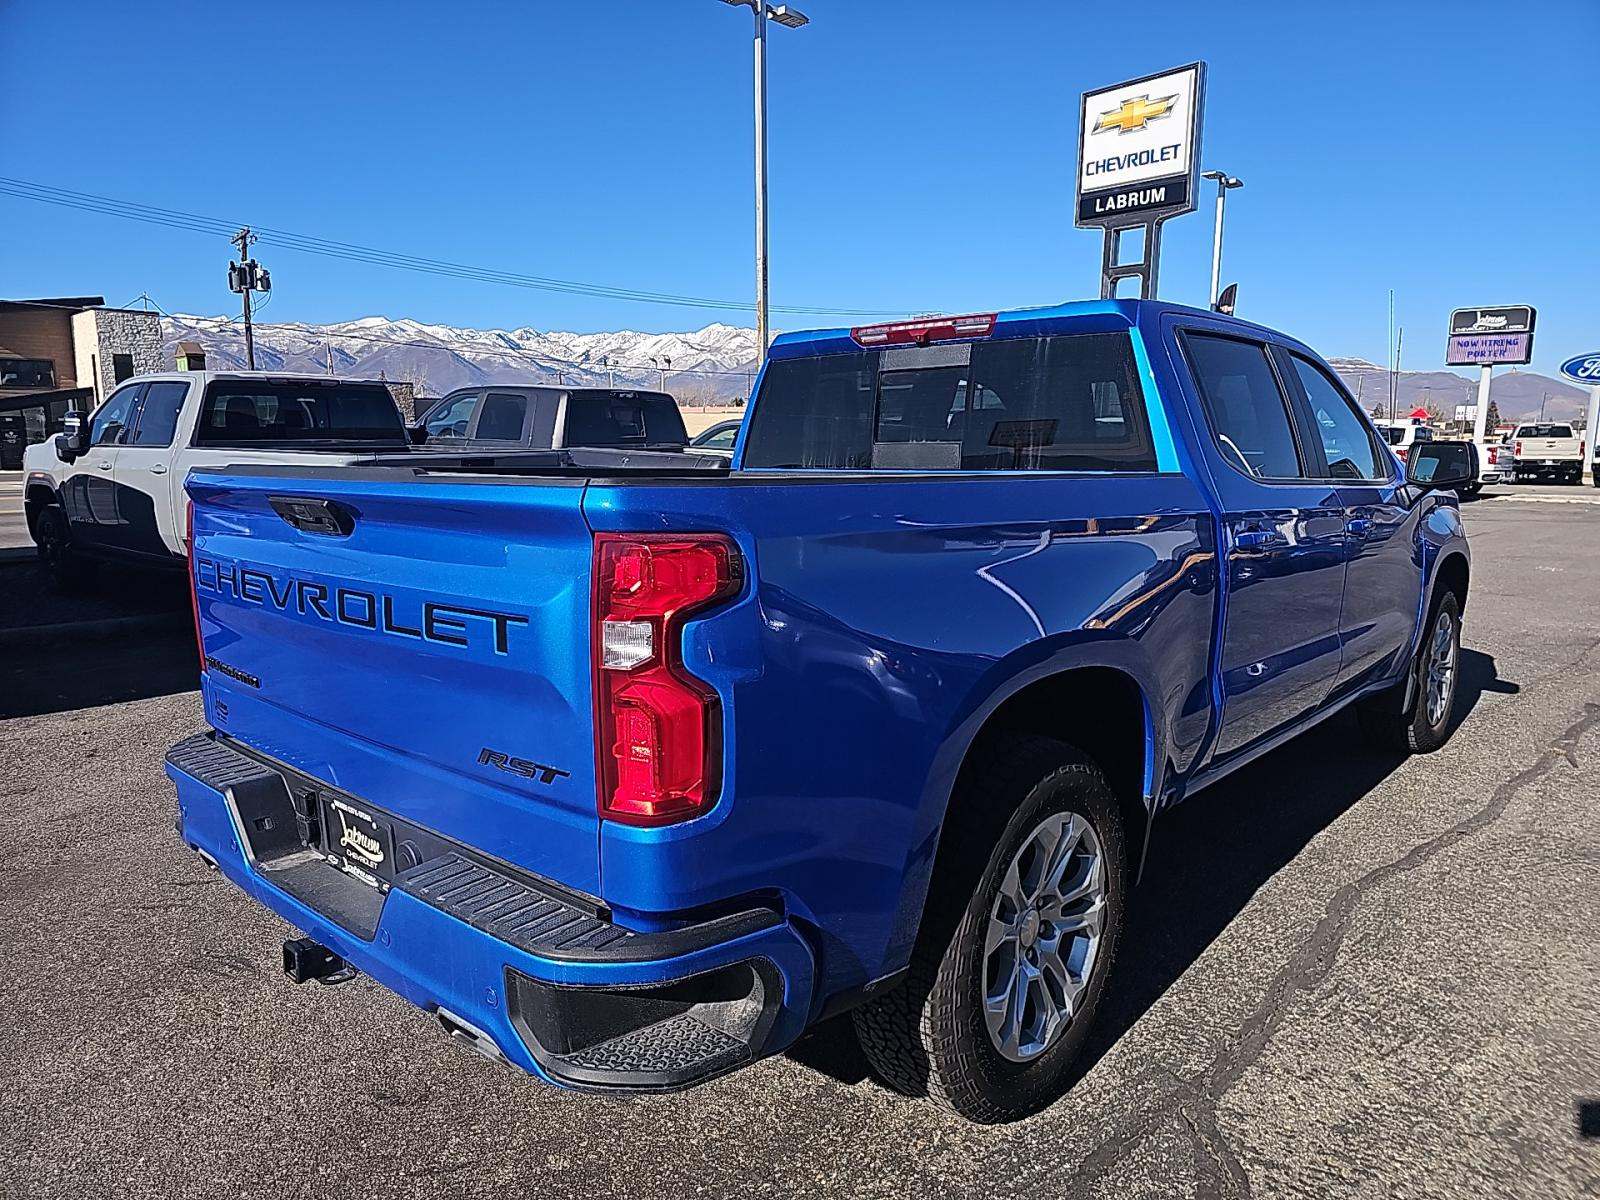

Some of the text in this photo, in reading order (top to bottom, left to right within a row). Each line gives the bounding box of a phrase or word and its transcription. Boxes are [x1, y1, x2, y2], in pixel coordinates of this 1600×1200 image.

[1085, 143, 1182, 176] CHEVROLET
[1095, 187, 1166, 212] LABRUM
[1457, 338, 1519, 348] NOW HIRING
[1467, 349, 1507, 358] PORTER
[1577, 358, 1600, 377] Fo
[198, 558, 530, 656] CHEVROLET
[477, 746, 571, 785] RST
